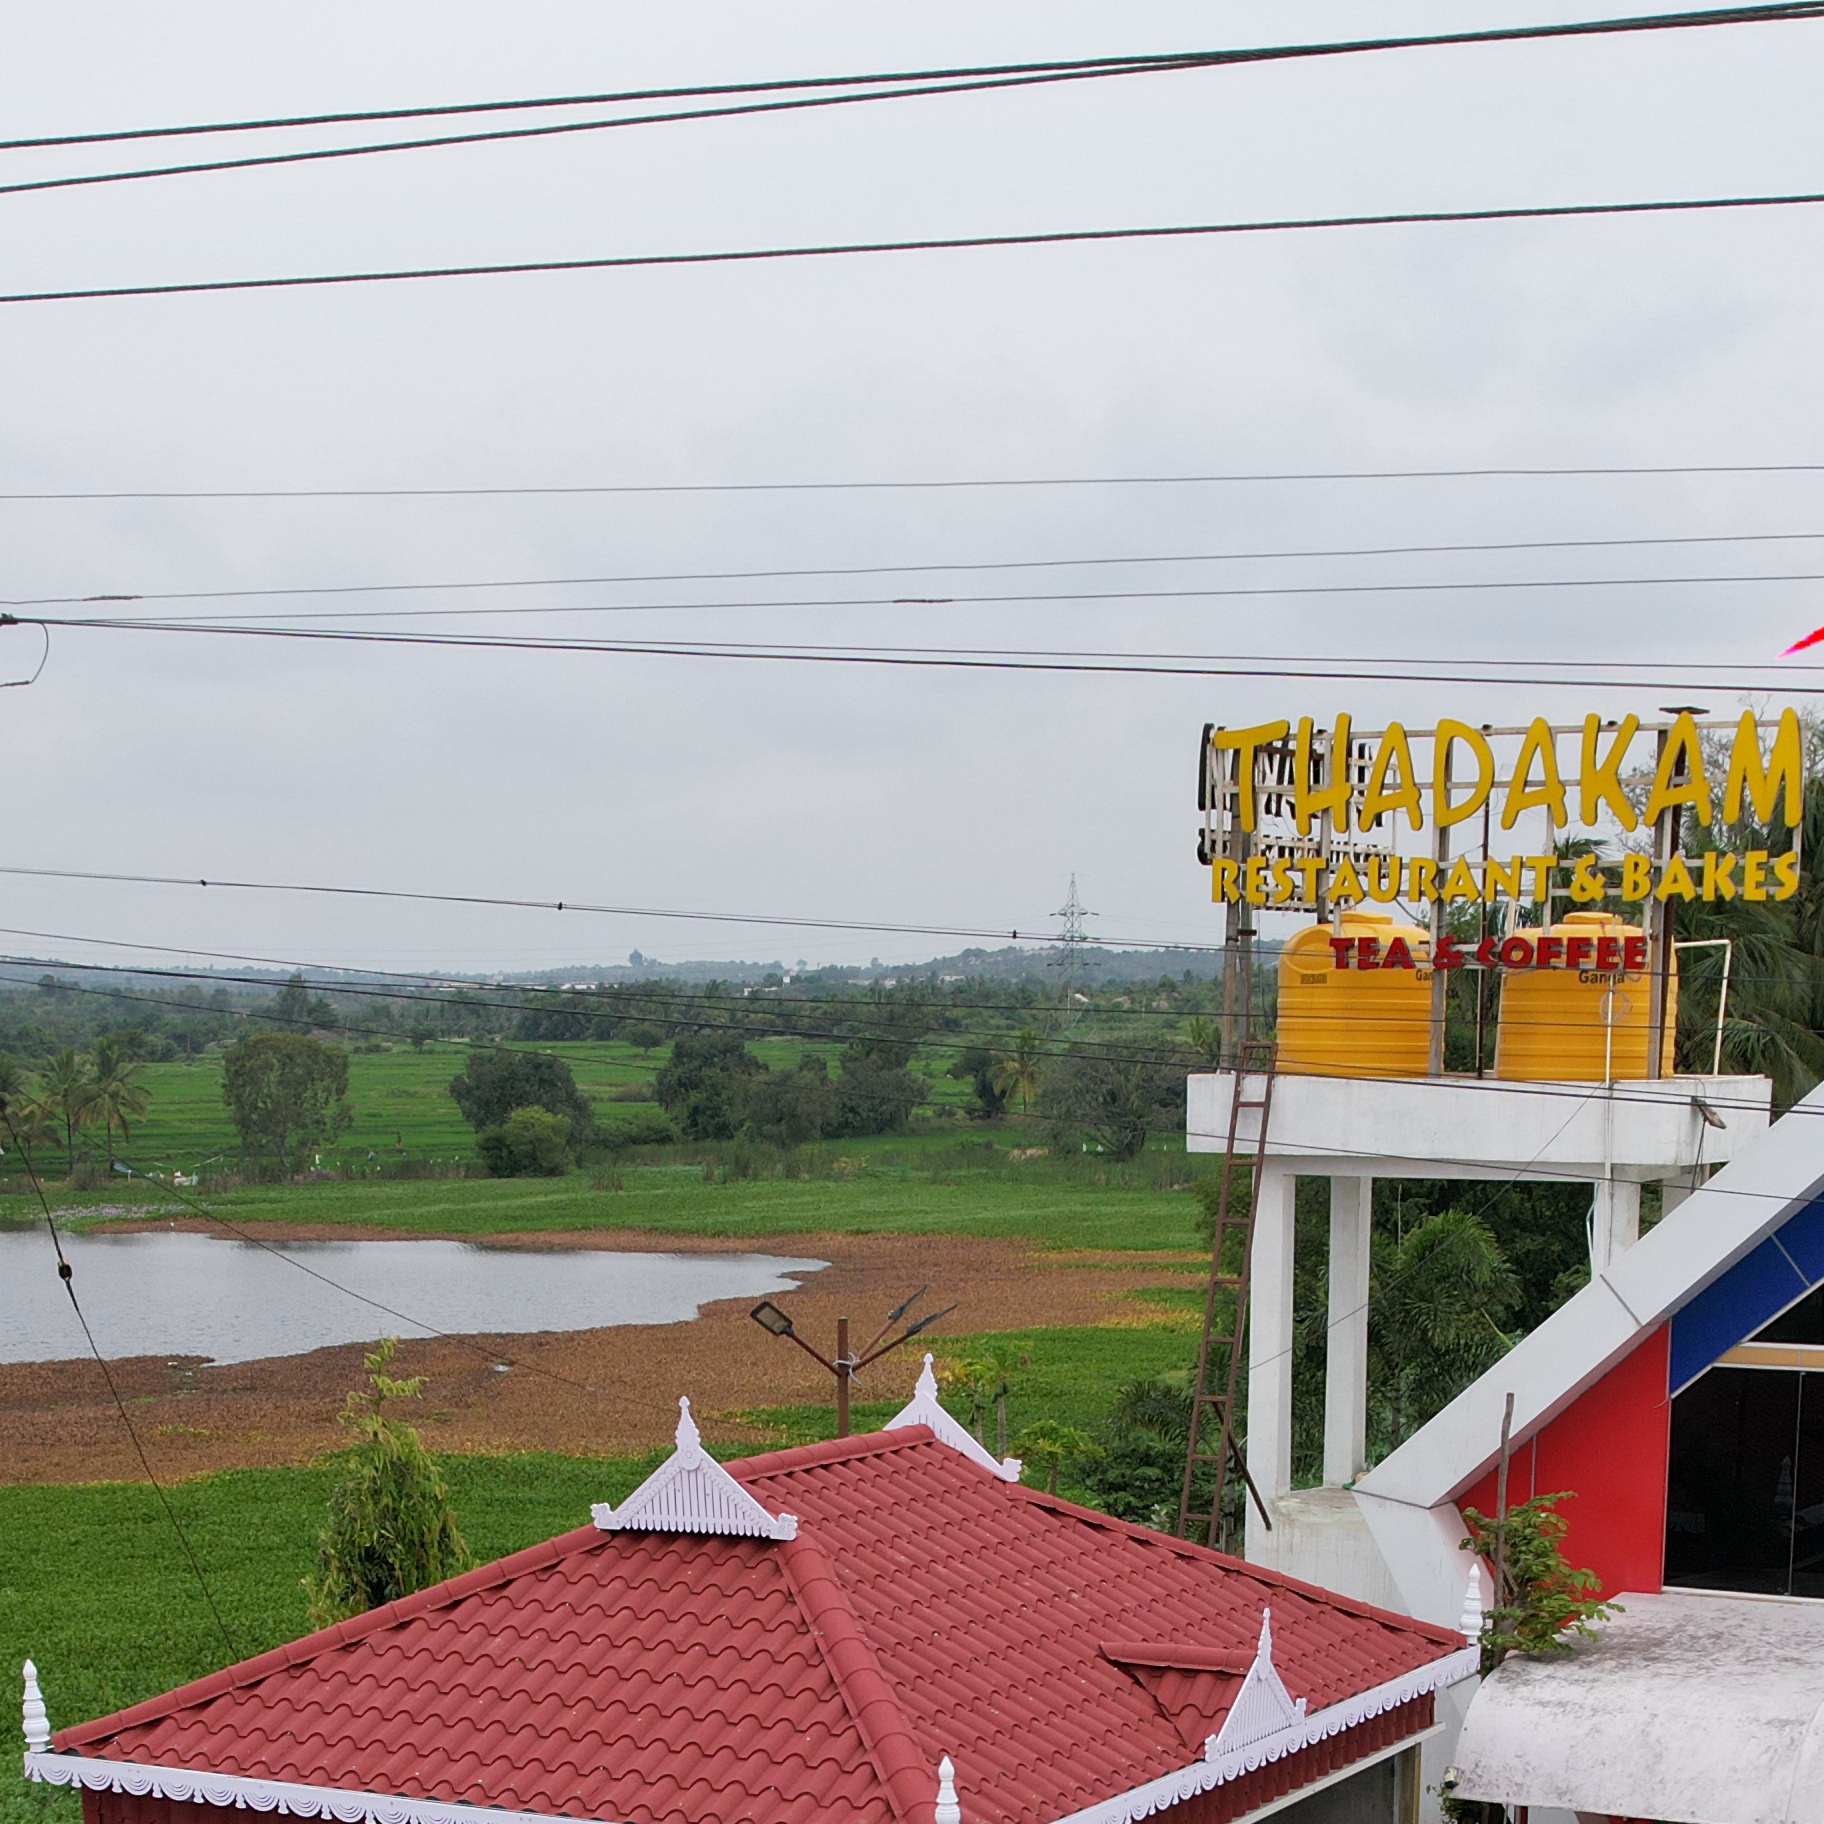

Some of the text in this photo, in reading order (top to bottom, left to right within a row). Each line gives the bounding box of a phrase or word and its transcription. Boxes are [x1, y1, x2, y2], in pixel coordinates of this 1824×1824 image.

[1214, 707, 1803, 836] THADAKAM
[1211, 850, 1801, 905] RESTAURANT & BAKES
[1329, 935, 1649, 971] TEA & COFFEE
